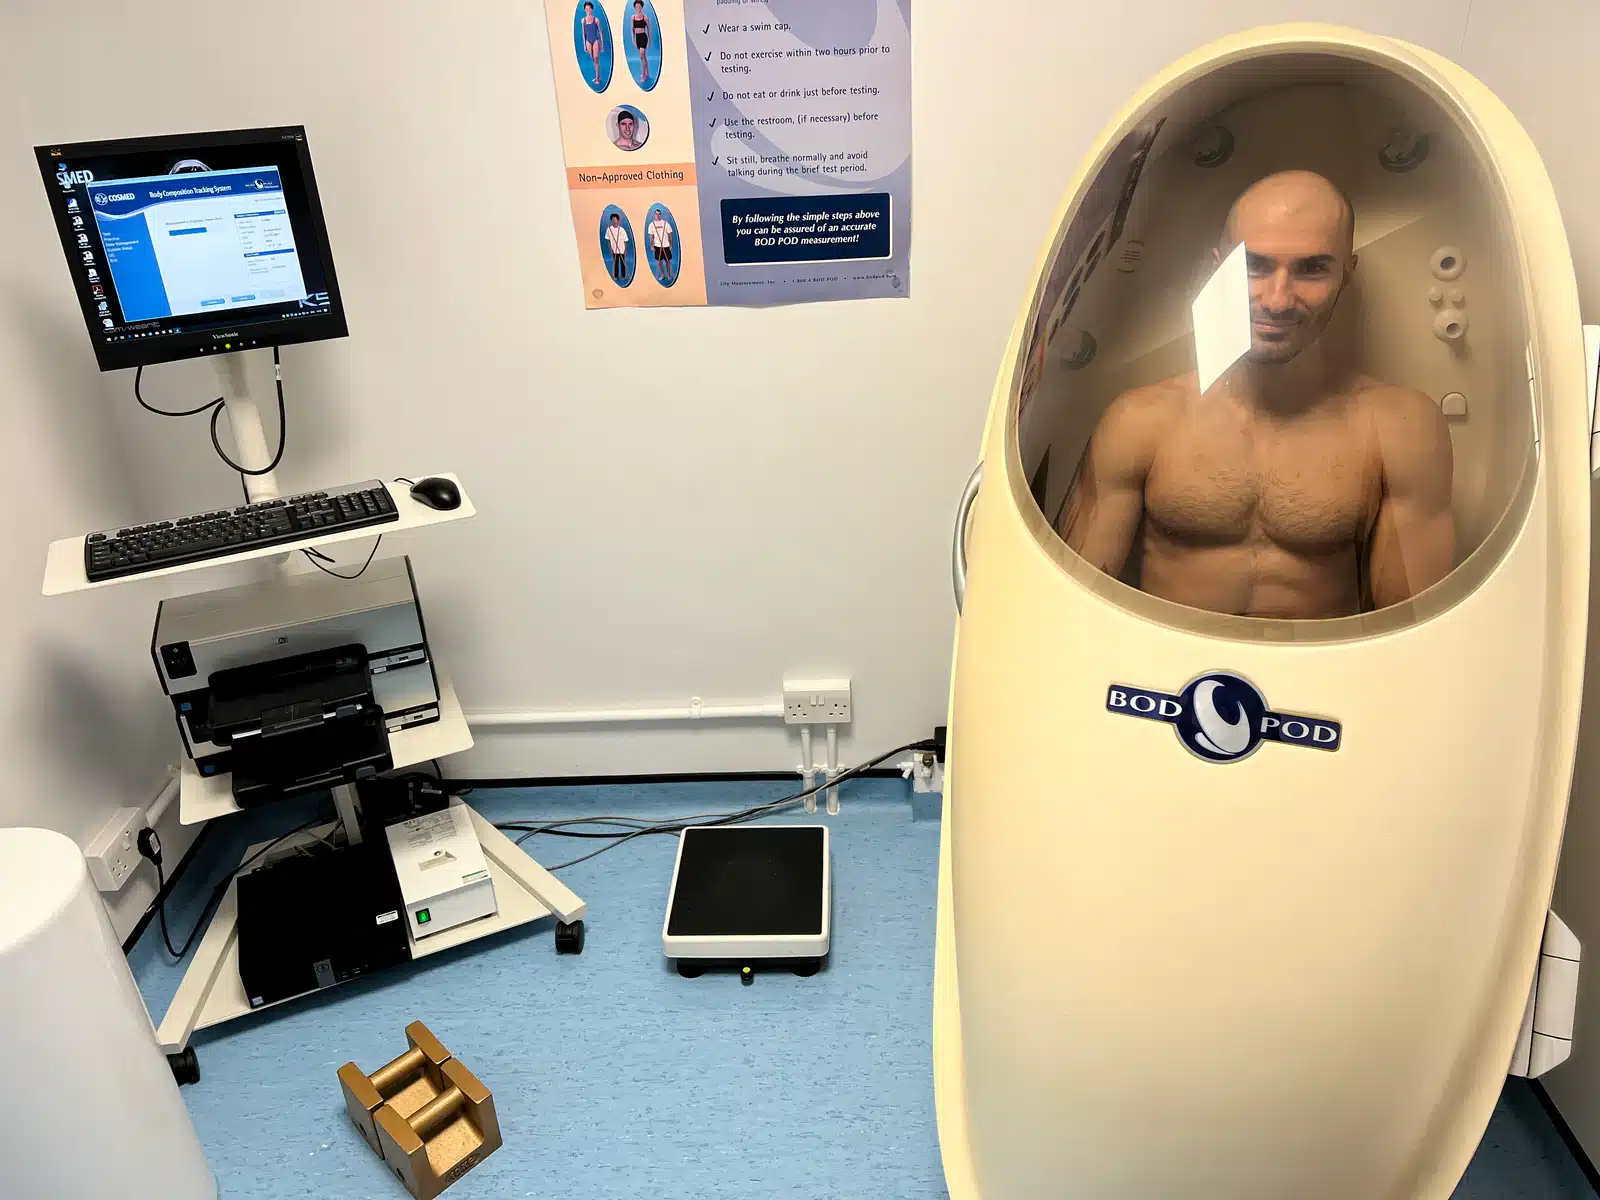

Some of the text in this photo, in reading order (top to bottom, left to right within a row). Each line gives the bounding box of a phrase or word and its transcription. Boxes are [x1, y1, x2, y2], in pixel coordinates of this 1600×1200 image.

[718, 24, 739, 32] Wear
[750, 22, 771, 31] swim
[774, 23, 791, 32] cap.
[720, 46, 890, 60] Do not exercise within two hours prior to
[721, 64, 752, 74] testing.
[722, 86, 880, 100] Do not eat or drink just before testing.
[724, 112, 878, 126] Use the restroom, (if necessary) before
[726, 130, 755, 140] testing.
[726, 151, 868, 165] Sit still, breathe normally and avoid
[578, 170, 684, 183] Non-Approved Clothing
[728, 164, 867, 178] talking during the brief test period.
[108, 192, 135, 202] COSMED
[149, 185, 232, 200] Body Composition Tracking System
[732, 210, 880, 225] By following the simple steps above
[736, 222, 876, 237] you can be assured of an accurate
[754, 234, 860, 246] BOD POD measurement!
[212, 331, 239, 340] ViewSonic
[1110, 690, 1338, 744] BOD POD
